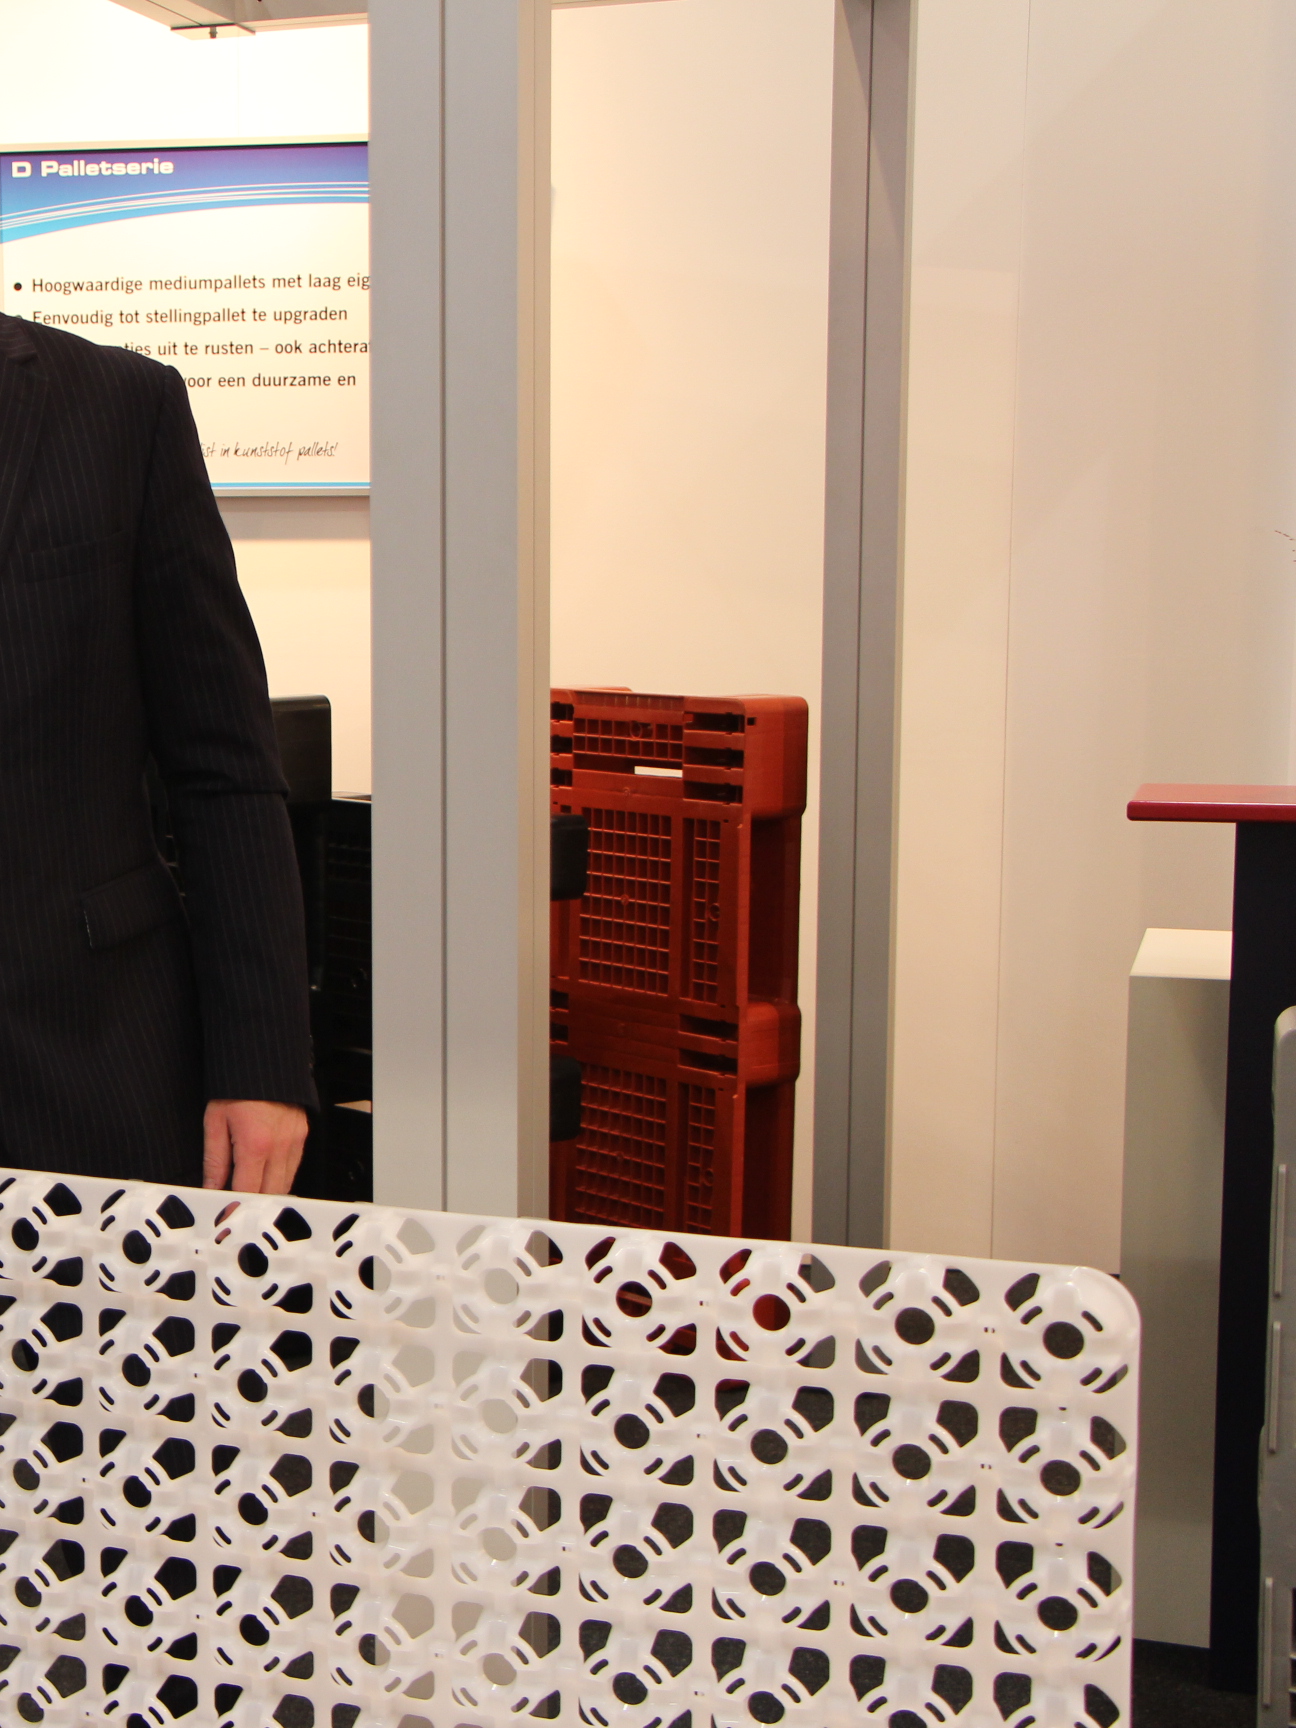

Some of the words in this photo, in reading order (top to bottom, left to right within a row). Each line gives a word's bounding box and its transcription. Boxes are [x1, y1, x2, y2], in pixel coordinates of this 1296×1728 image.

[12, 161, 32, 178] D
[40, 157, 174, 177] Palletserie
[32, 276, 143, 296] Hoogwaardige
[149, 275, 266, 293] mediumpallets
[272, 274, 302, 289] met
[308, 273, 341, 291] laag
[33, 310, 113, 327] Eenvoudig
[119, 309, 140, 324] tot
[146, 308, 246, 326] stellingpallet
[252, 308, 267, 322] te
[273, 306, 348, 325] upgraden
[124, 341, 151, 356] ties
[158, 340, 178, 356] uit
[184, 342, 199, 355] te
[204, 341, 254, 355] rusten
[275, 339, 303, 354] ook
[308, 339, 370, 354] achtera
[218, 376, 246, 388] een
[252, 373, 332, 387] duurzame
[337, 375, 357, 387] en
[220, 443, 230, 458] in
[234, 441, 293, 465] kunststof
